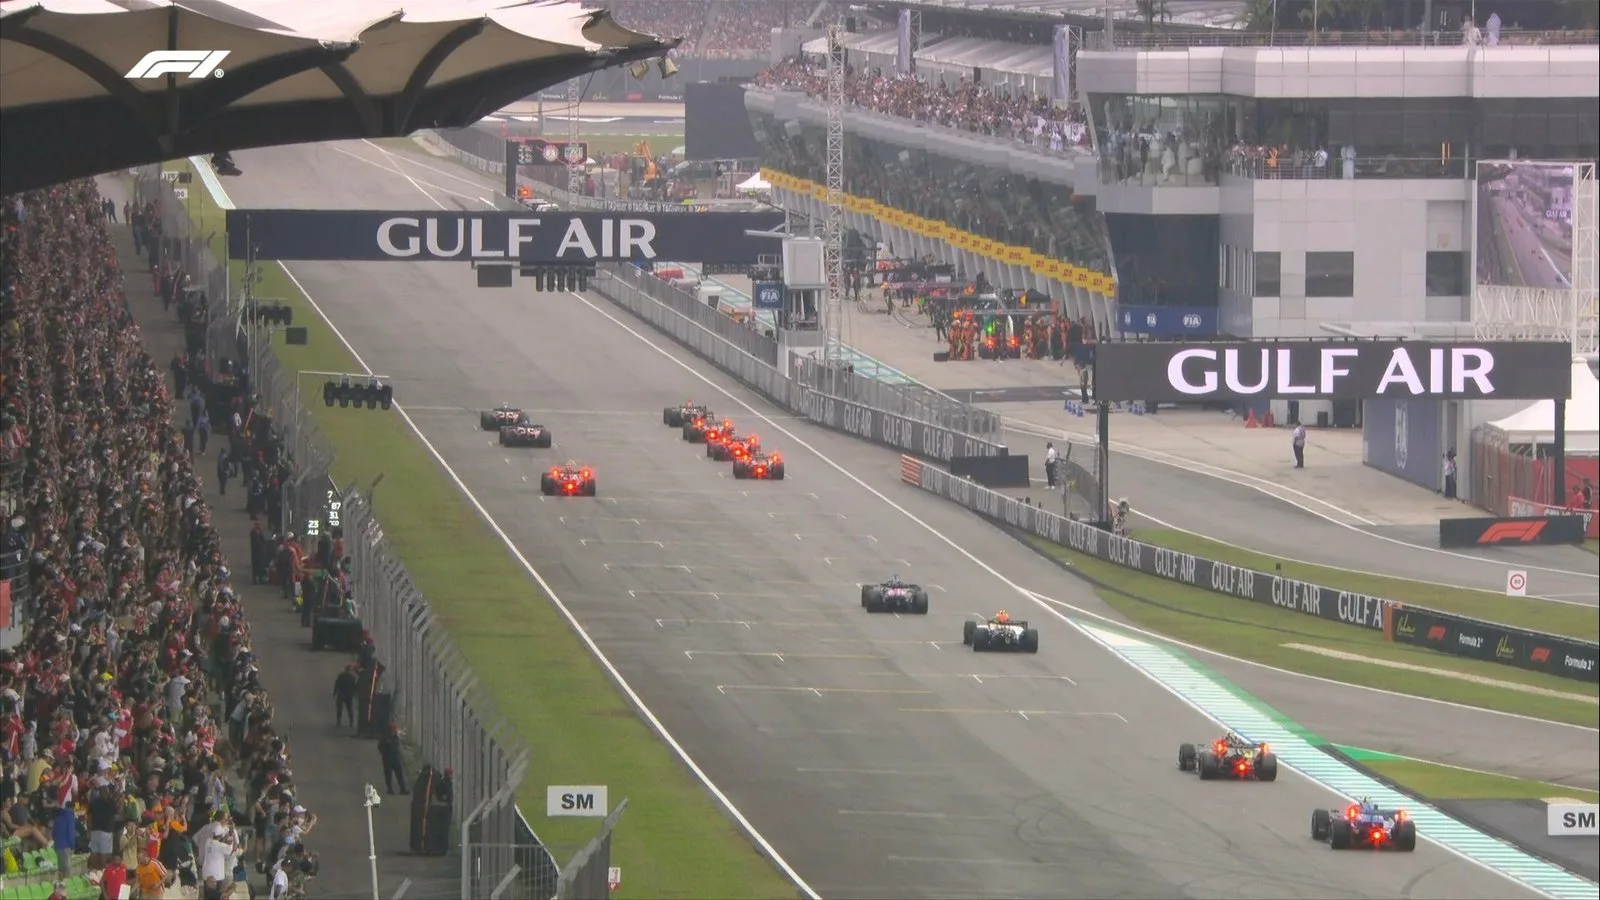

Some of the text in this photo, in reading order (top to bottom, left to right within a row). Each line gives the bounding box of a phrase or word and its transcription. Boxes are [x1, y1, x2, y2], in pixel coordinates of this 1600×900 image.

[376, 217, 657, 258] GULF AIR
[761, 291, 778, 301] FIA
[1184, 316, 1199, 326] FIA
[1167, 347, 1495, 395] GULF AIR
[882, 414, 899, 445] GULF
[923, 426, 941, 457] GULF
[331, 502, 341, 510] 87
[308, 520, 319, 528] 23
[1069, 520, 1097, 555] GULF AIR
[1108, 534, 1140, 569] GULF AIR
[1155, 547, 1196, 584] GULF AIR
[1212, 561, 1254, 599] GULF AIR
[1272, 576, 1321, 615] GULF AIR
[1338, 591, 1373, 625] GULF
[1459, 633, 1477, 647] Formula
[1564, 655, 1587, 669] Formula
[561, 793, 594, 809] SM
[1563, 812, 1596, 828] SM
